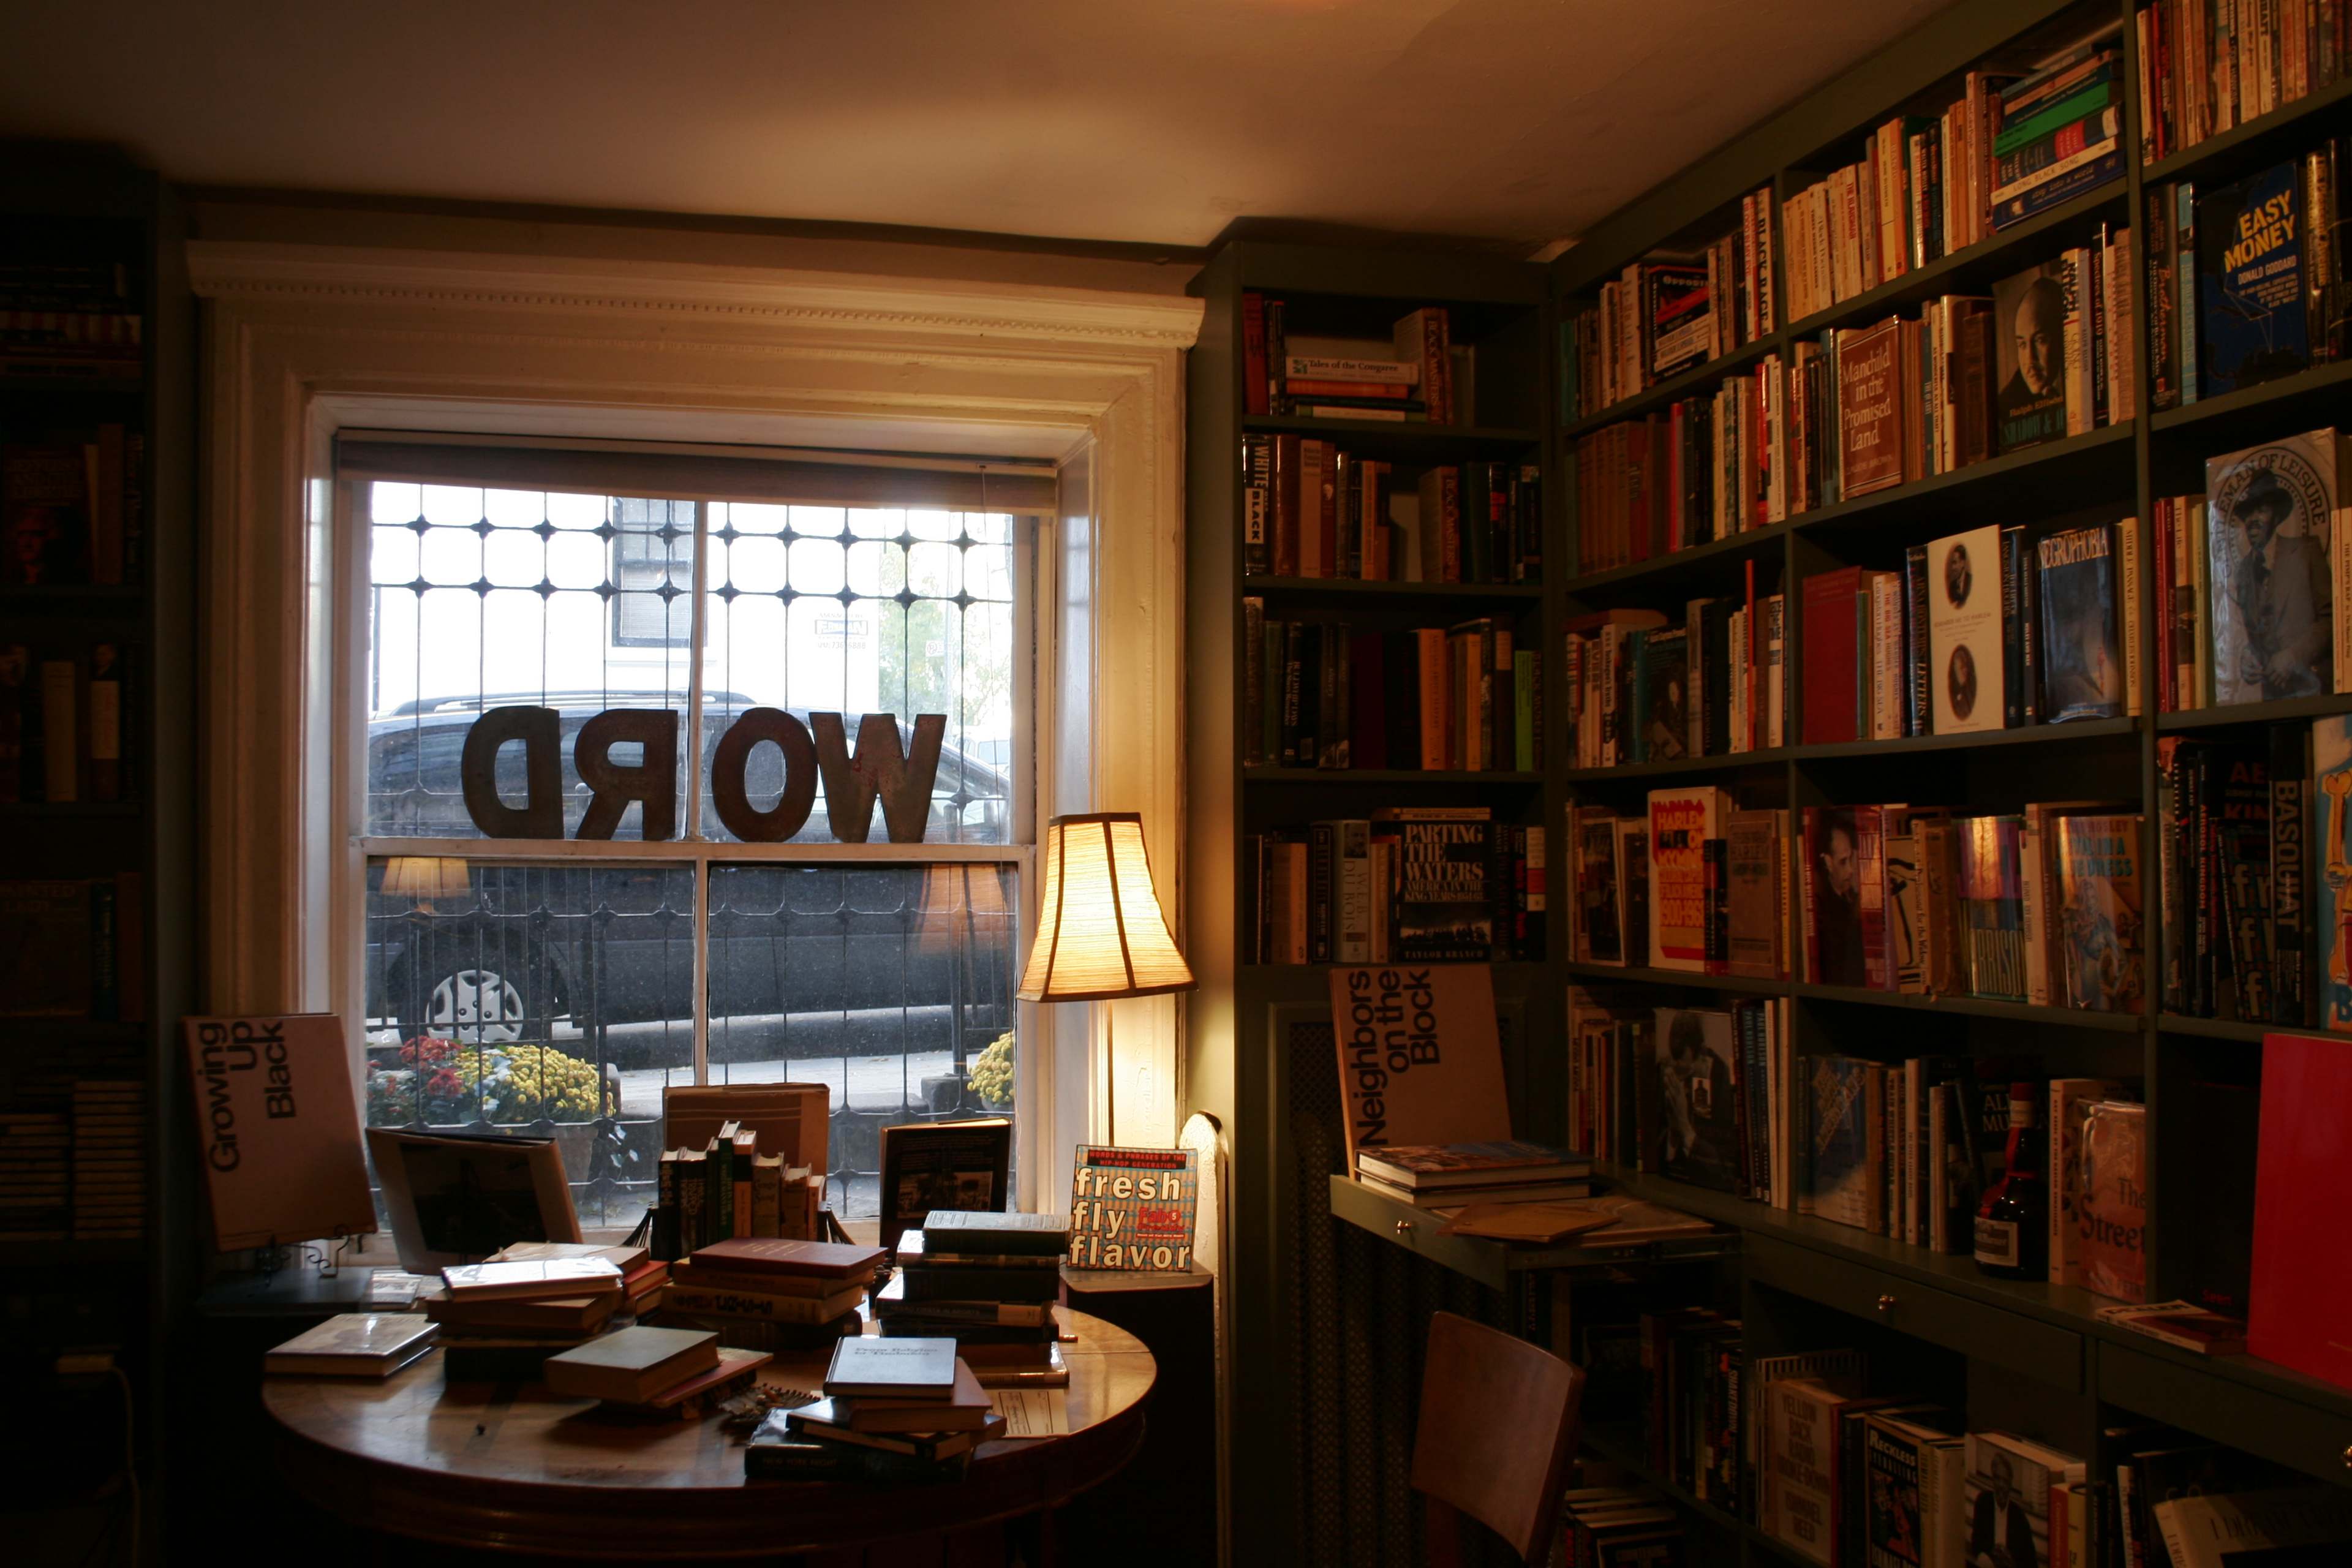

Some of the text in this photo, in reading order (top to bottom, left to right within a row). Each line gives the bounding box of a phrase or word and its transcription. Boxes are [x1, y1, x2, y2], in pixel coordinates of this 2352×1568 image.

[2013, 157, 2079, 192] LONG BLACK SONG
[2239, 189, 2293, 239] EASY
[2224, 214, 2296, 273] MONEY
[1757, 217, 1768, 323] BLACK RAGE
[2068, 260, 2078, 311] RALPH
[2093, 252, 2103, 295] Spectres
[2237, 255, 2297, 285] DONALD GODDARD
[2095, 296, 2102, 310] of
[2158, 266, 2173, 363] Brotherman
[1427, 319, 1438, 355] BLACK
[1308, 359, 1329, 368] Tales
[1331, 360, 1340, 369] of
[1359, 362, 1398, 373] Congaree
[1842, 350, 1891, 385] Manchild
[1855, 375, 1884, 402] in the
[1843, 398, 1891, 430] Promised
[1849, 422, 1880, 452] Land
[1254, 445, 1269, 489] WHITE
[1444, 478, 1453, 513] BLACK
[2278, 454, 2326, 526] LEISURE
[1251, 491, 1260, 541] BLACK
[2038, 526, 2109, 570] NEGROPHOBIA
[1874, 581, 1883, 621] Langston
[1874, 622, 1883, 655] Hughes
[1917, 663, 1926, 716] LETTERS
[1404, 824, 1485, 844] PARTING
[1657, 812, 1703, 831] HARLEM
[1404, 843, 1446, 862] THE
[2117, 837, 2125, 856] A
[2275, 780, 2300, 932] BASQUIAT
[1404, 862, 1485, 882] WATERS
[2087, 859, 2132, 876] DRESS
[1343, 860, 1356, 931] DU BOIS
[1357, 872, 1367, 914] W.E.B.
[1404, 892, 1455, 902] KING YEARS
[1406, 881, 1484, 892] AMERICA IN THE
[1917, 913, 1926, 925] for
[1918, 927, 1927, 938] the
[1405, 950, 1485, 959] TAYLOR BRANCH
[1918, 940, 1928, 965] Widow
[1374, 970, 1404, 1025] the
[1402, 968, 1441, 1065] Block
[227, 1020, 257, 1071] Up
[1348, 970, 1389, 1145] Neighbors
[1385, 1030, 1409, 1074] on
[262, 1019, 296, 1119] Black
[198, 1022, 241, 1172] Growing
[1076, 1167, 1182, 1201] fresh
[1072, 1200, 1126, 1240] fly
[1137, 1207, 1167, 1224] Fab
[1070, 1235, 1191, 1270] flavor
[1781, 1393, 1817, 1423] YELLOW
[1868, 1428, 1917, 1466] RECKLESS
